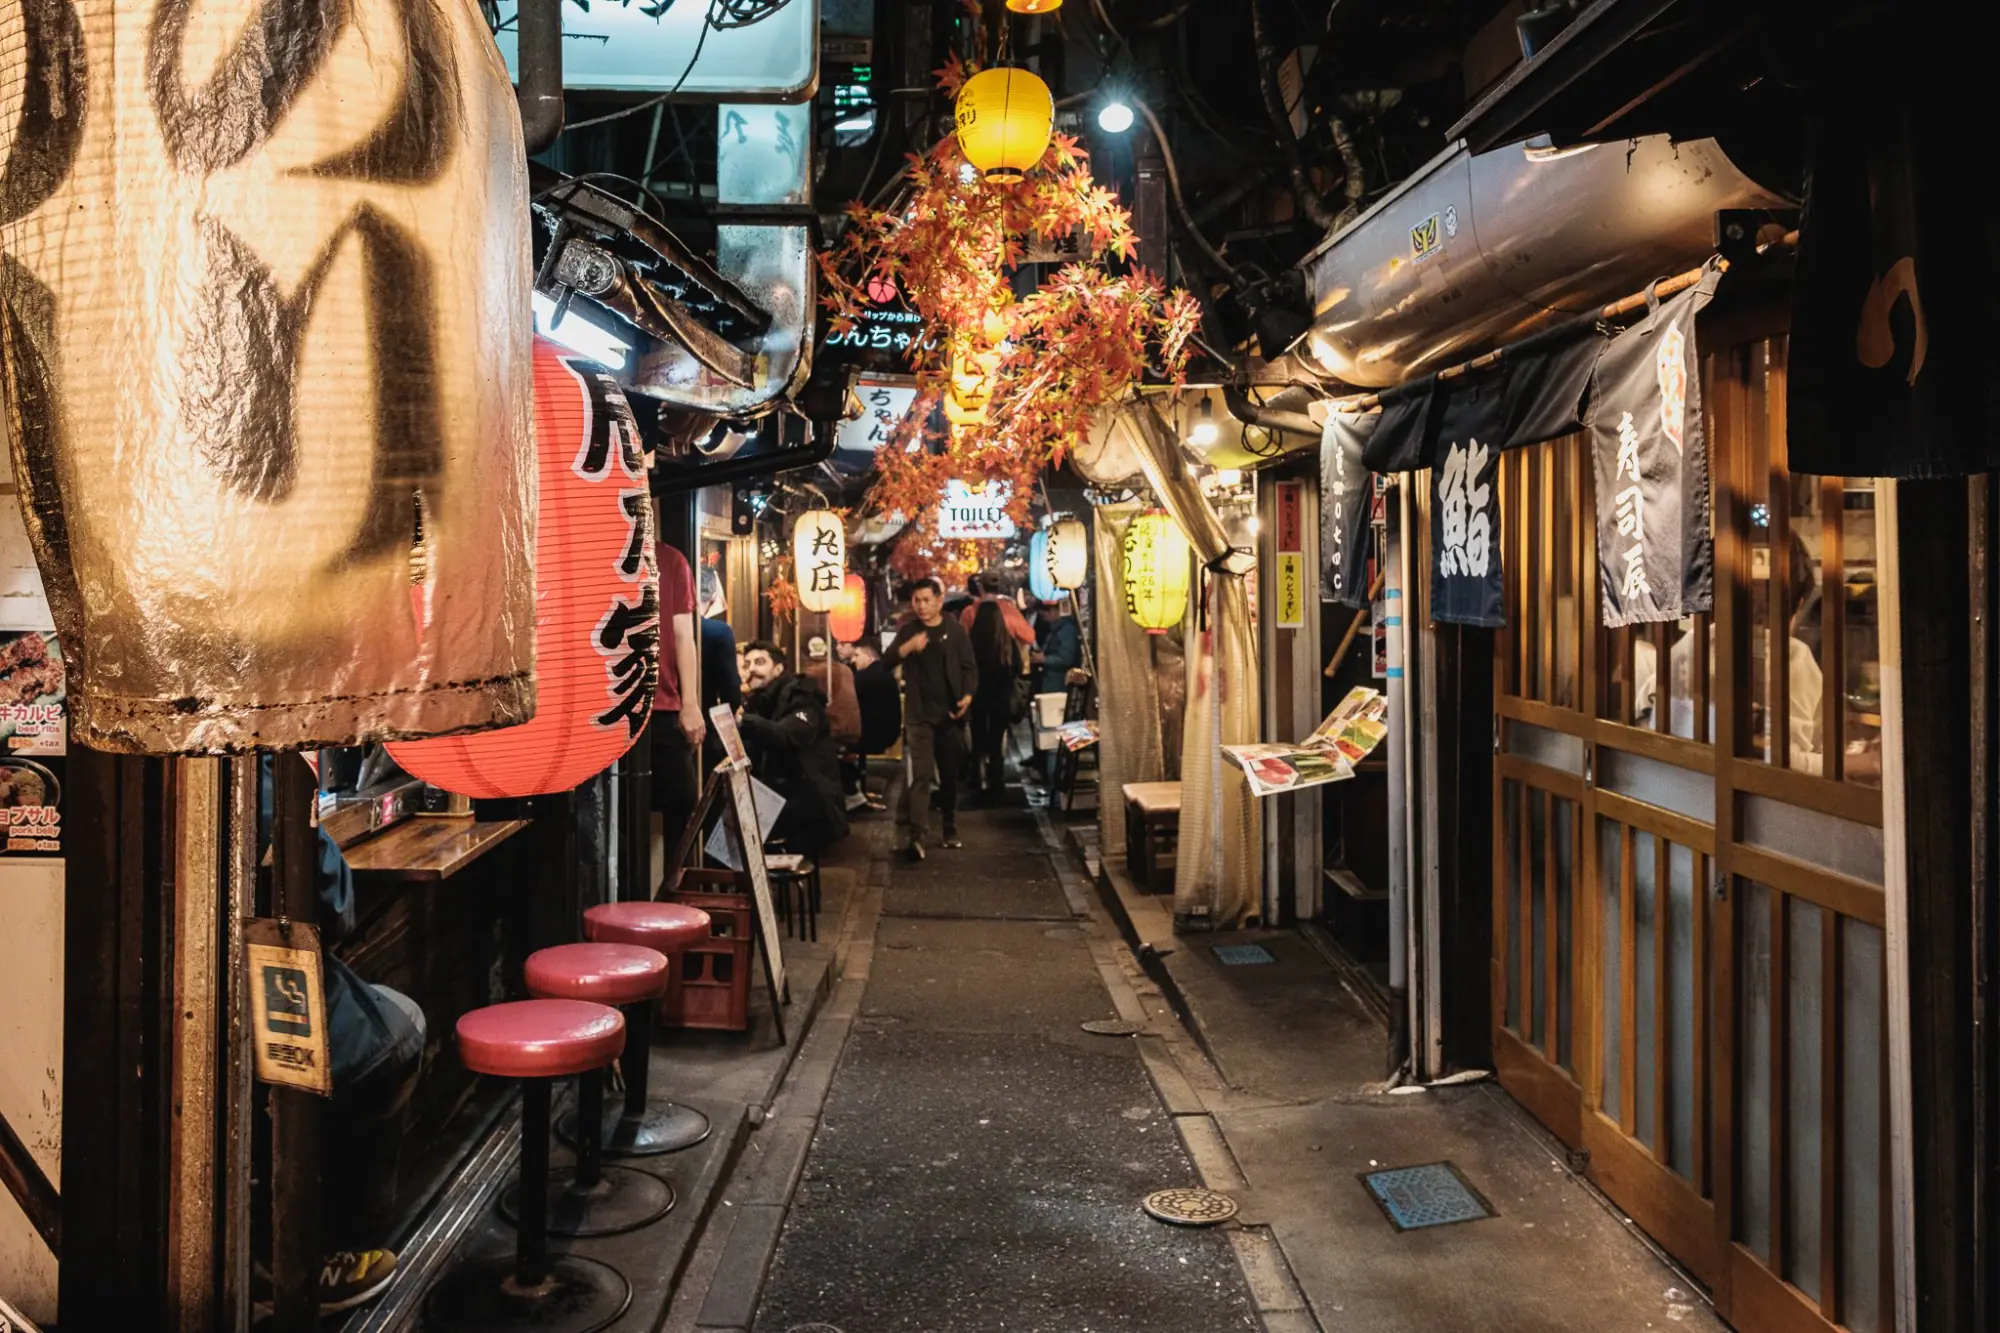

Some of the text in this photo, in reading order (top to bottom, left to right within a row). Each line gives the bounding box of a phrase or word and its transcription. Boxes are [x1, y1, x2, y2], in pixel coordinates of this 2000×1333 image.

[1438, 438, 1491, 578] 鮨
[1615, 411, 1651, 599] 寿司辰
[0, 706, 60, 721] 牛カルビ
[18, 725, 60, 733] beef ribs
